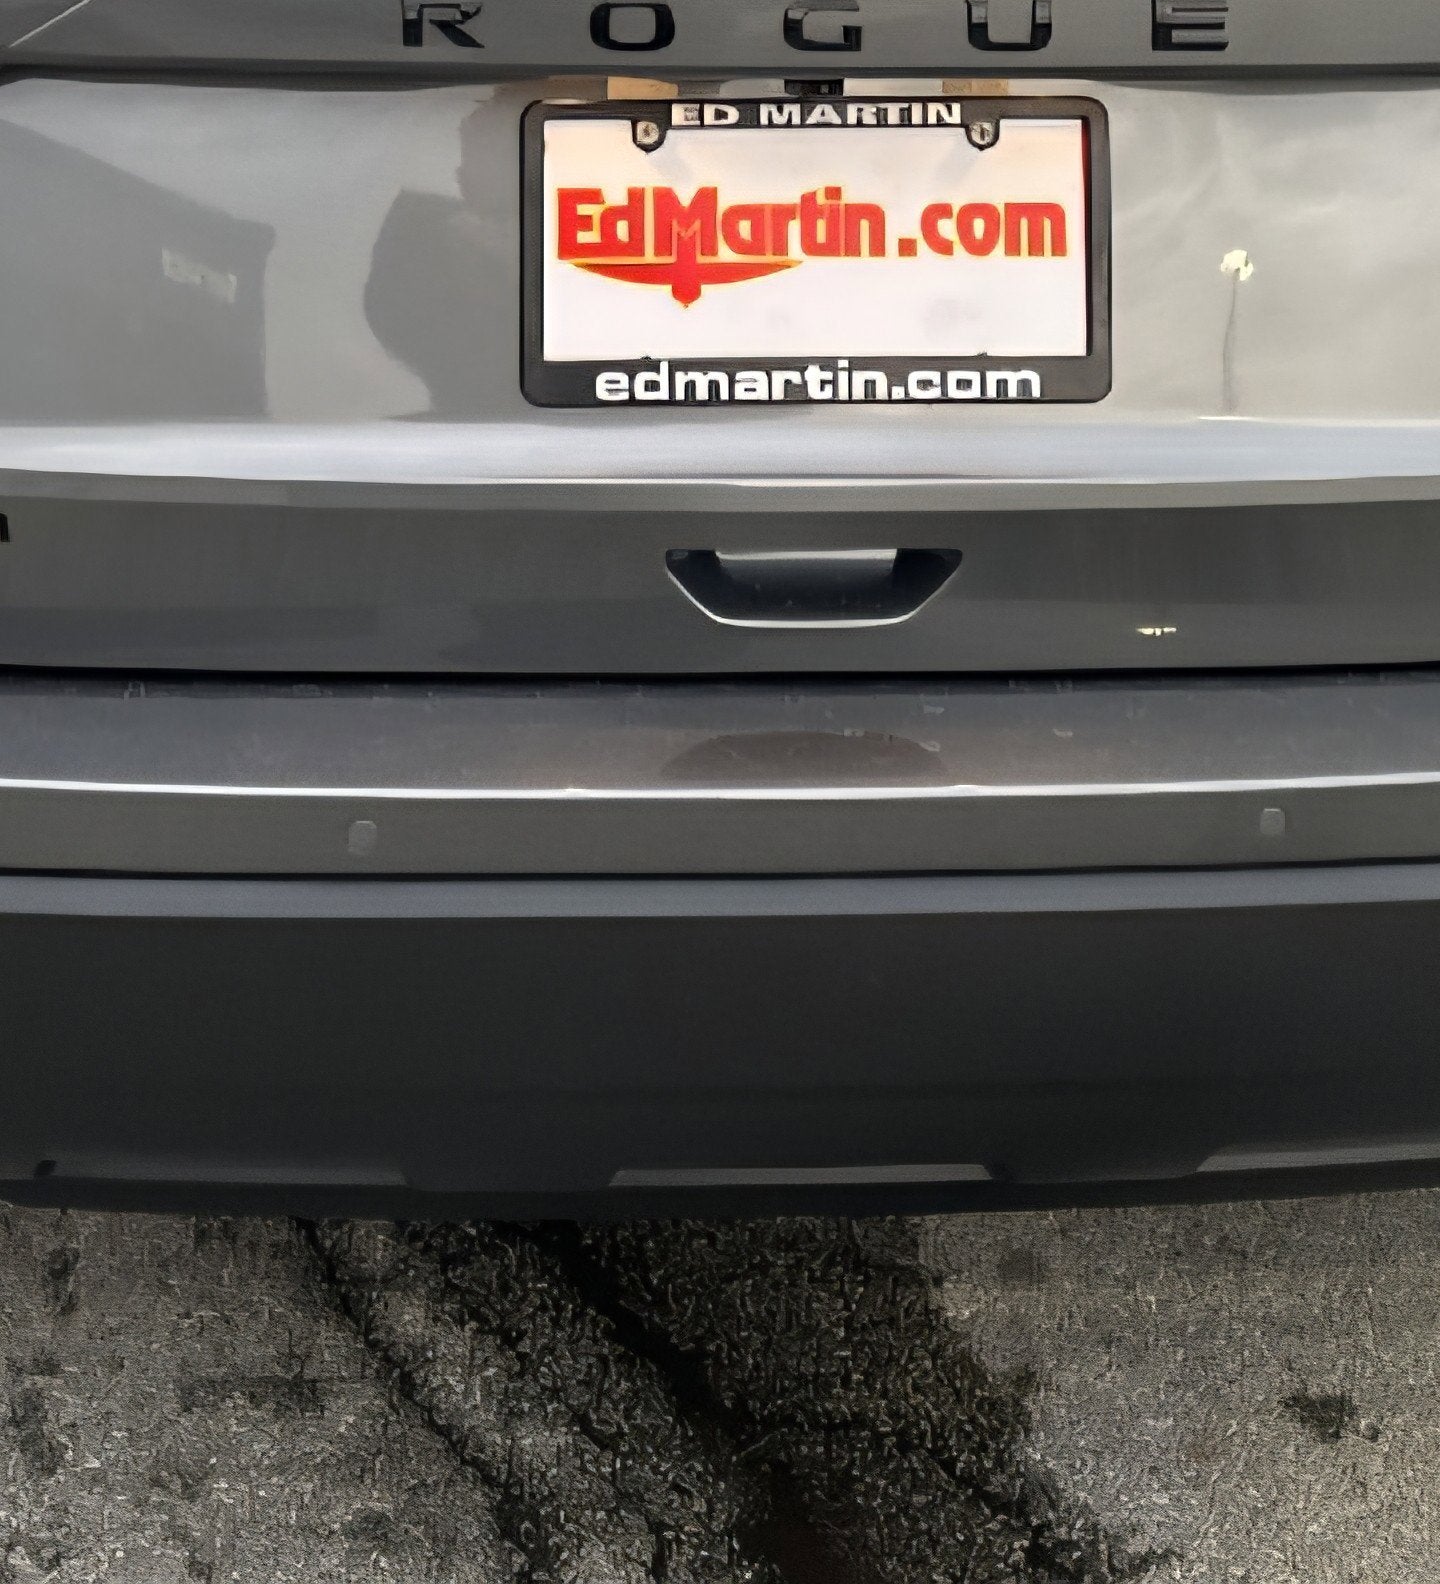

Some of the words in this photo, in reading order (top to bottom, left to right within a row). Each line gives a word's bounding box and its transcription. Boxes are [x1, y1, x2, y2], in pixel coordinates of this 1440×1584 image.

[671, 103, 740, 126] ED
[761, 103, 961, 125] MARTIN
[557, 185, 1067, 266] EdMartin.com
[595, 360, 1042, 402] edmartin.com
